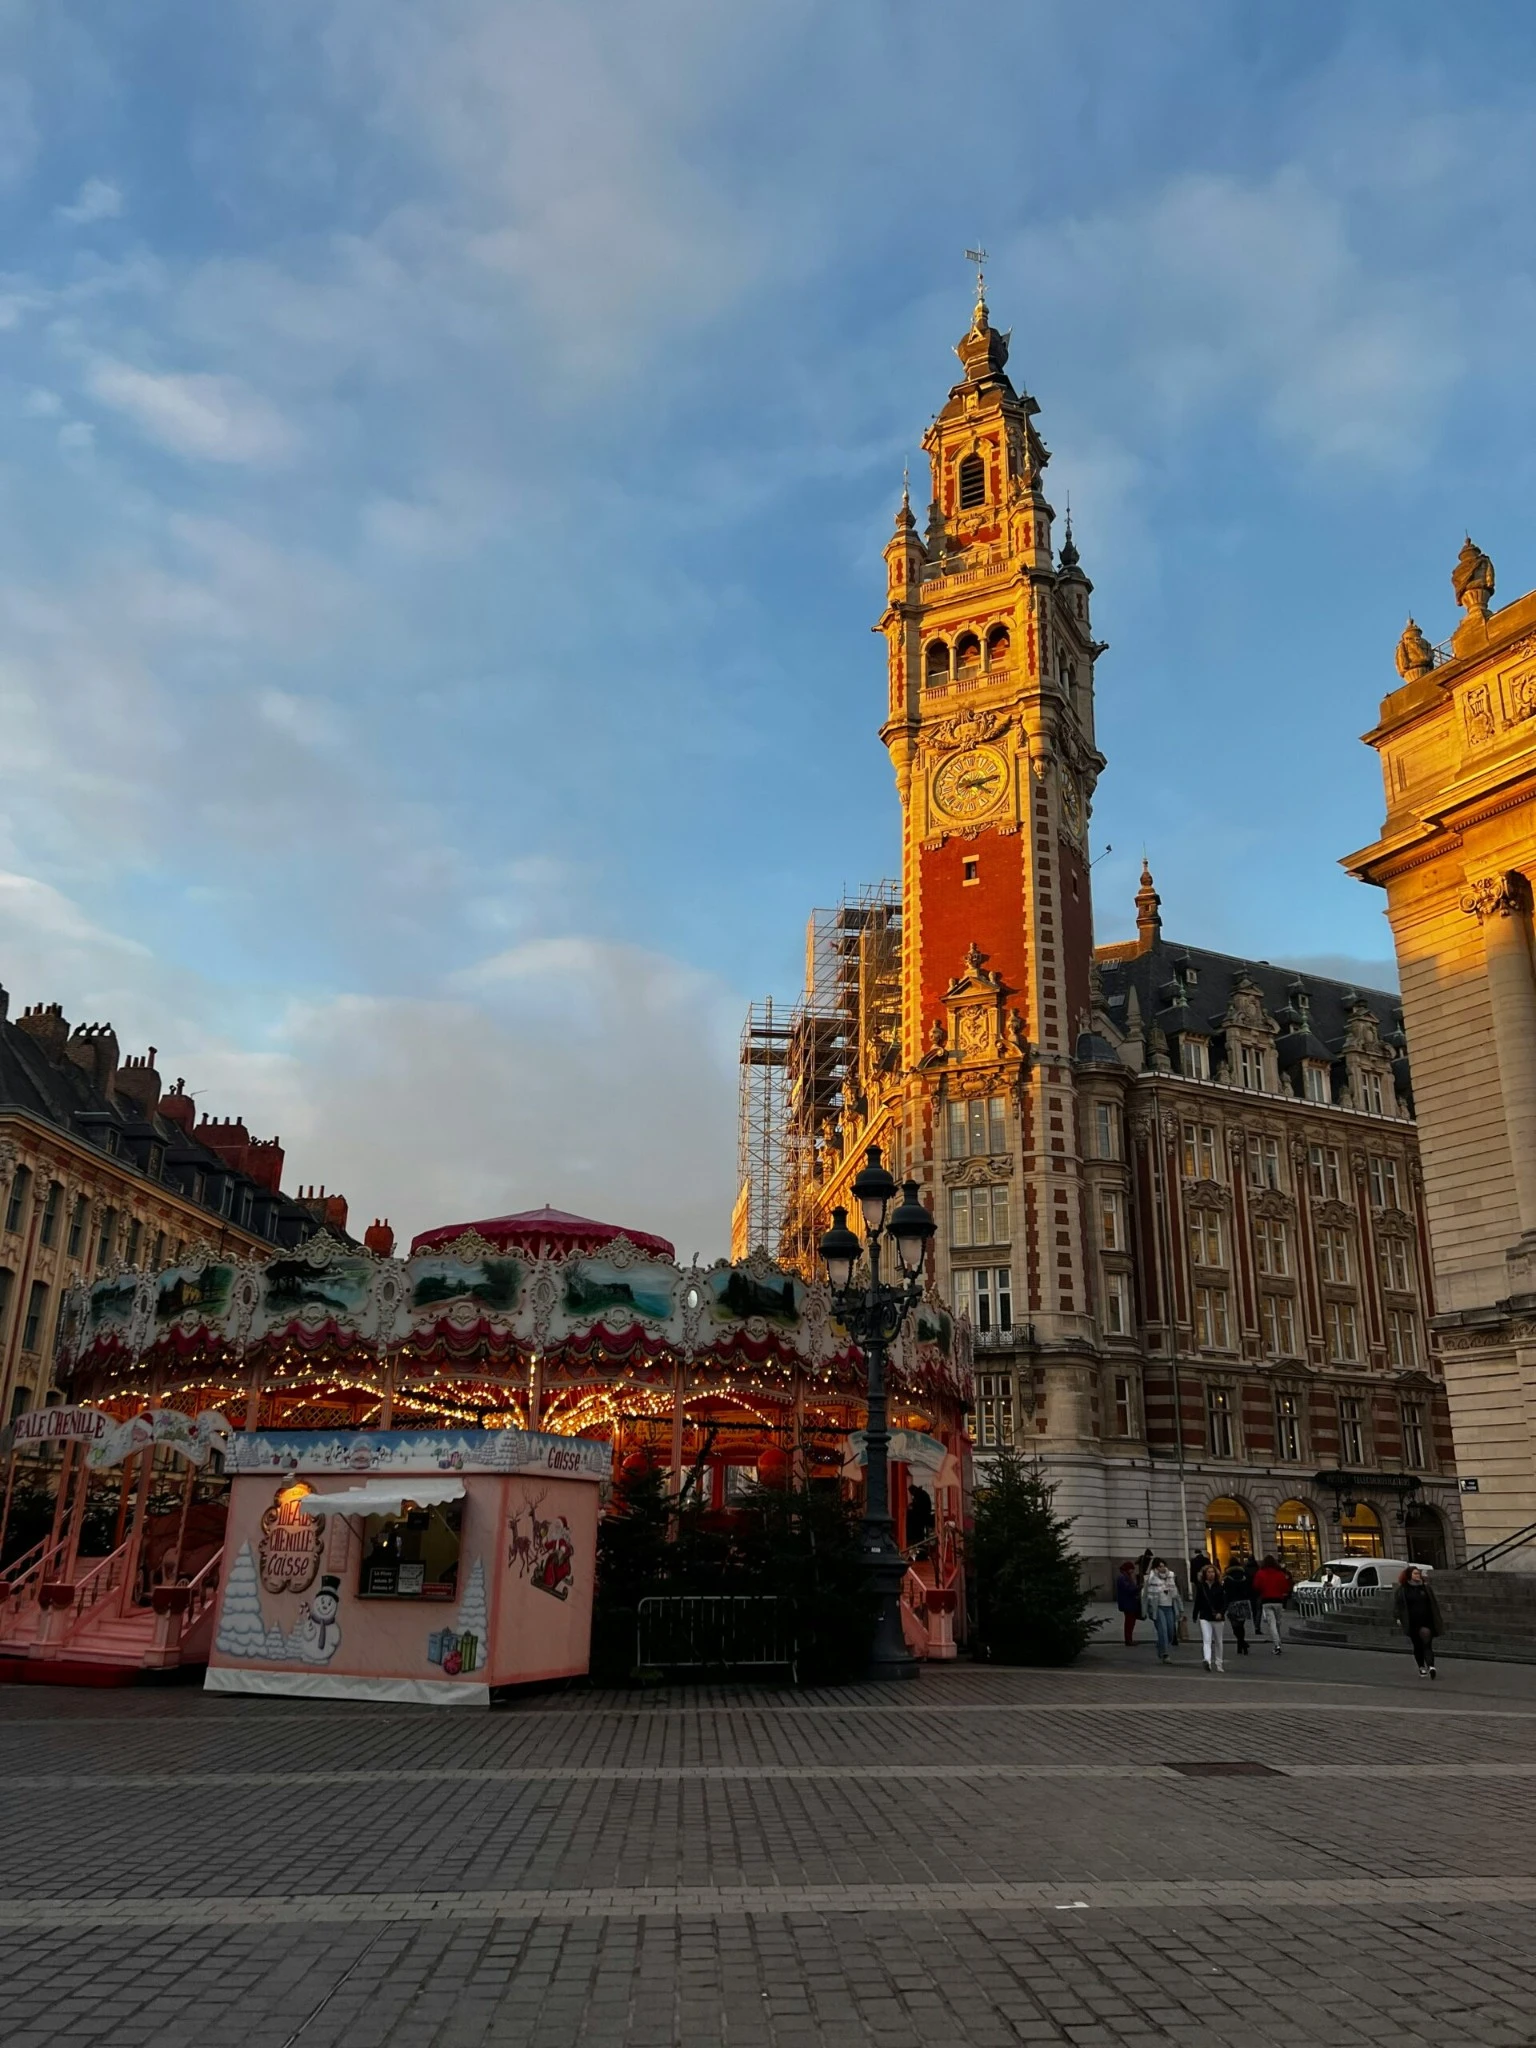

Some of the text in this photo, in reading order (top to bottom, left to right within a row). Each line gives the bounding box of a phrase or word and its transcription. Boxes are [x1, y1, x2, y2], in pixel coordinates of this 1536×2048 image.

[47, 1410, 106, 1439] CHENILLE
[548, 1446, 581, 1472] Caisse
[269, 1527, 315, 1552] CHENILLE
[267, 1552, 309, 1577] Caisse
